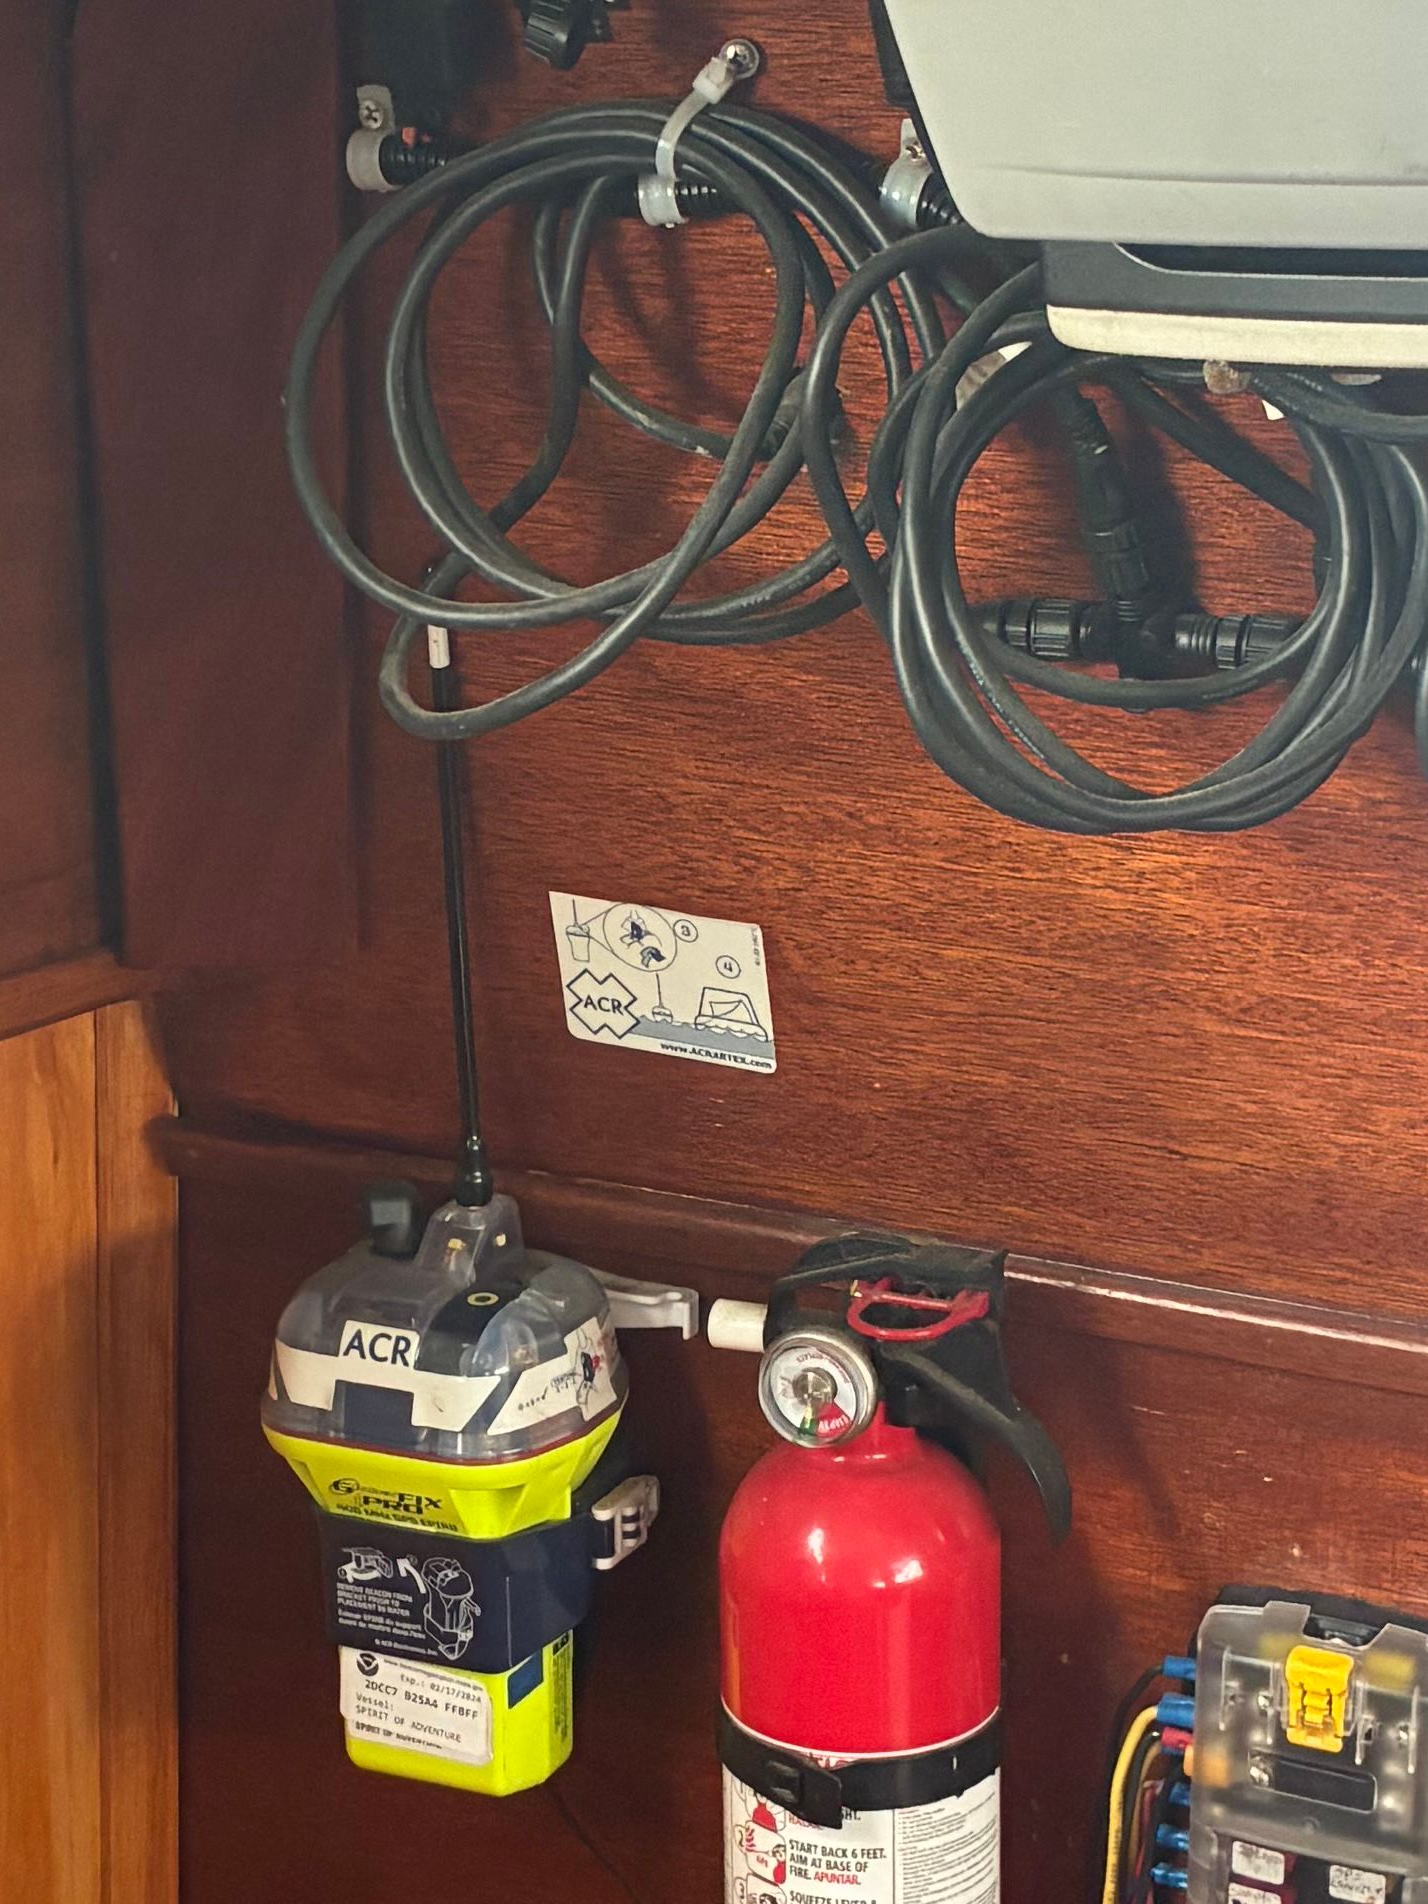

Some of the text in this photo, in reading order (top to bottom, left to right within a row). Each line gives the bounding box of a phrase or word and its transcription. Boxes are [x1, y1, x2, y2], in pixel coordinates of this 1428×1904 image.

[583, 994, 625, 1017] ACR
[343, 1328, 412, 1368] ACR
[365, 1679, 399, 1696] 2DCC7
[788, 1838, 887, 1860] START BACK 6 FEET.
[789, 1854, 869, 1873] AIM AT BASE OF
[789, 1865, 812, 1880] FIRE.
